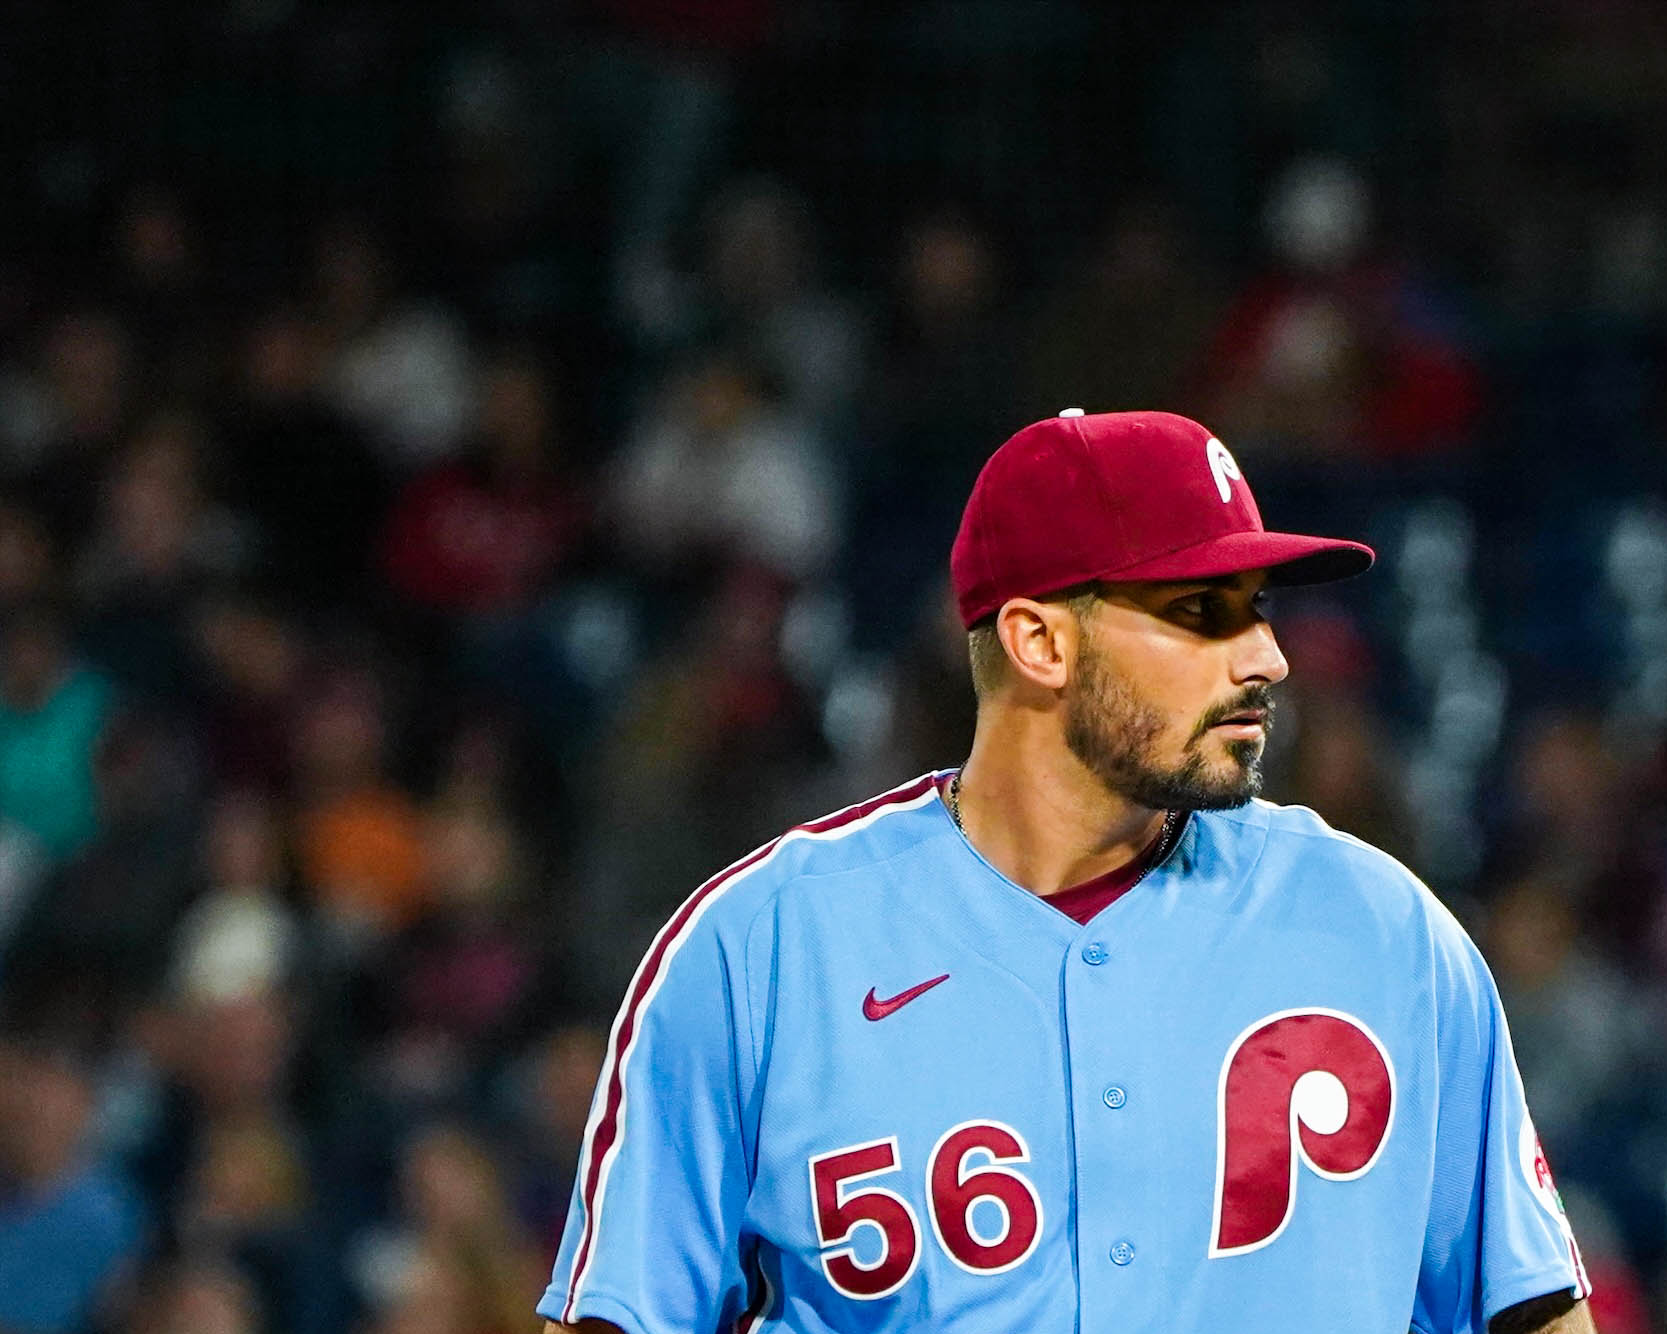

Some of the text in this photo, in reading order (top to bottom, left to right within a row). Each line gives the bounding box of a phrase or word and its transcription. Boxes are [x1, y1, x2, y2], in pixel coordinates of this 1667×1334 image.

[1205, 436, 1242, 504] P
[808, 1118, 1045, 1301] 56
[1208, 1006, 1397, 1260] P
